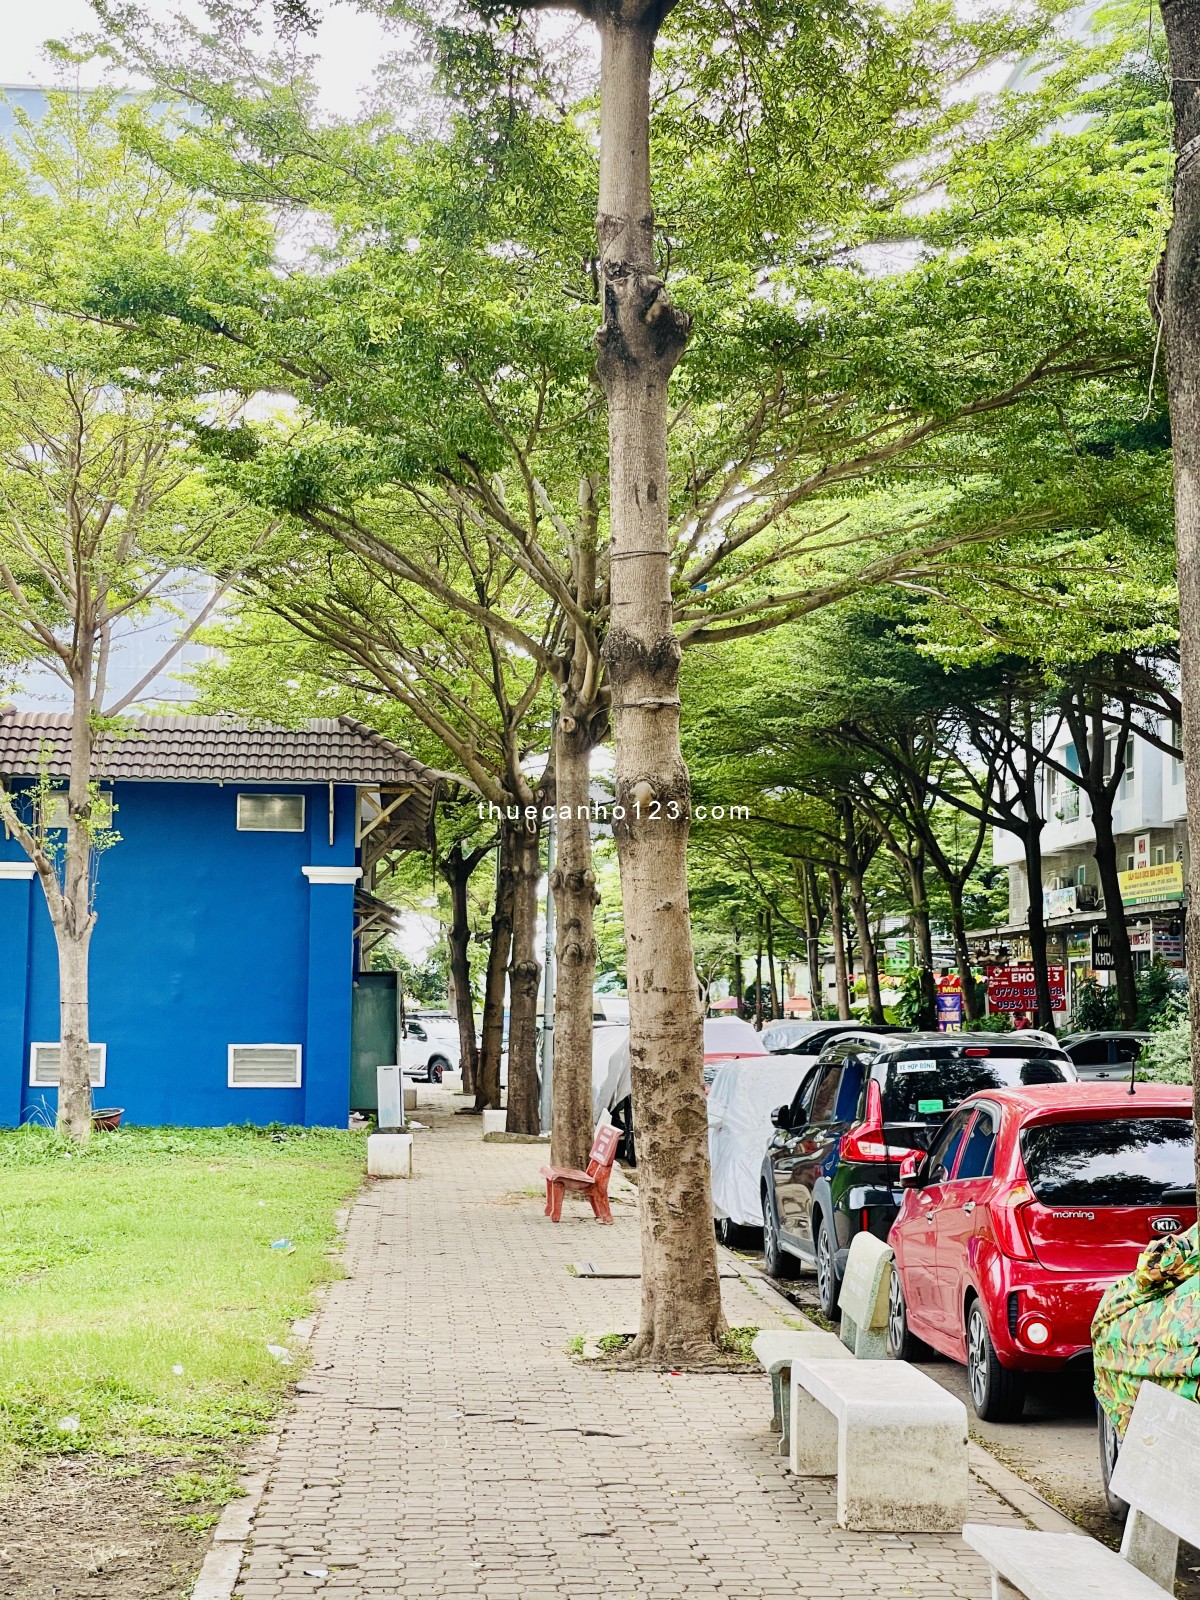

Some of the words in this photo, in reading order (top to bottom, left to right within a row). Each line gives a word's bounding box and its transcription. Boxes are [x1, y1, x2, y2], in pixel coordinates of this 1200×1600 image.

[1053, 971, 1060, 982] 3
[994, 987, 1020, 997] 0778
[996, 1000, 1024, 1010] 0934
[1052, 1210, 1095, 1220] morning
[1156, 1220, 1178, 1231] KIA
